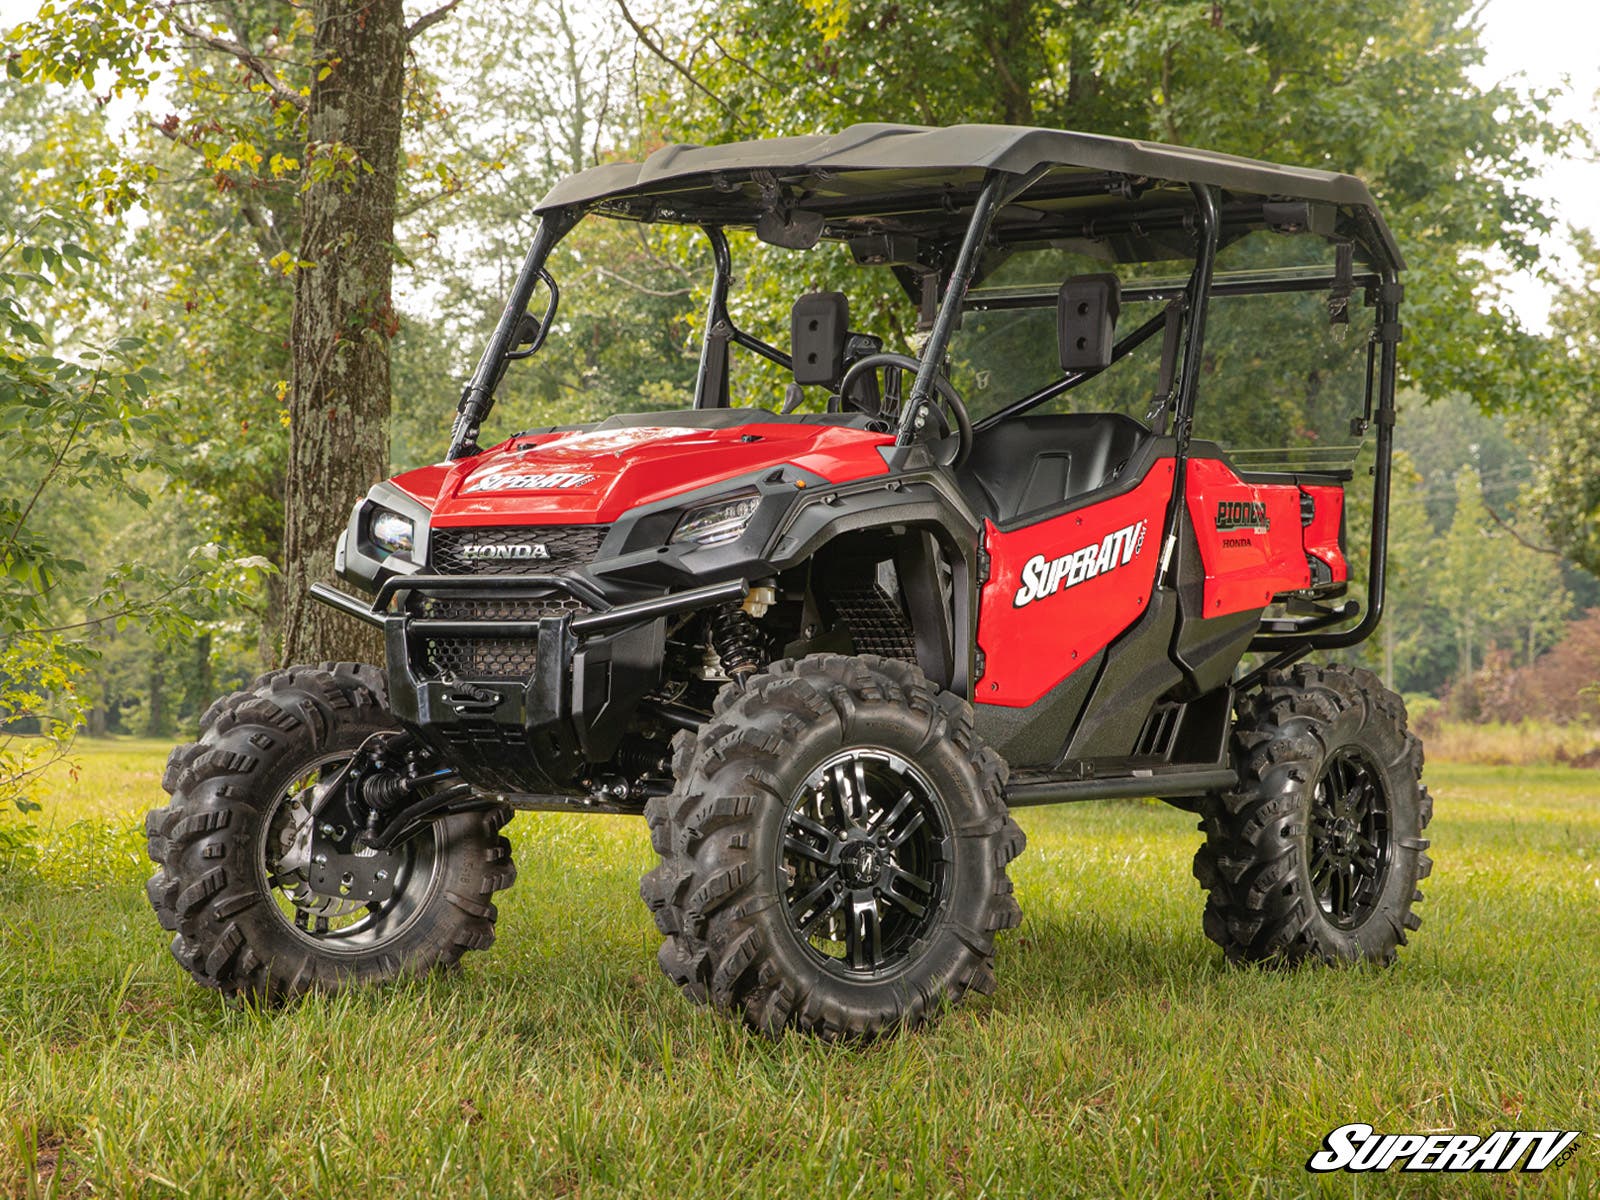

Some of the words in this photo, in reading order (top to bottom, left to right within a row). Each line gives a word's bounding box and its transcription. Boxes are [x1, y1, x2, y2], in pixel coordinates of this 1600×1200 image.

[1222, 538, 1252, 549] HONDA
[463, 544, 550, 559] HONDA
[1012, 520, 1144, 609] SUPERATV
